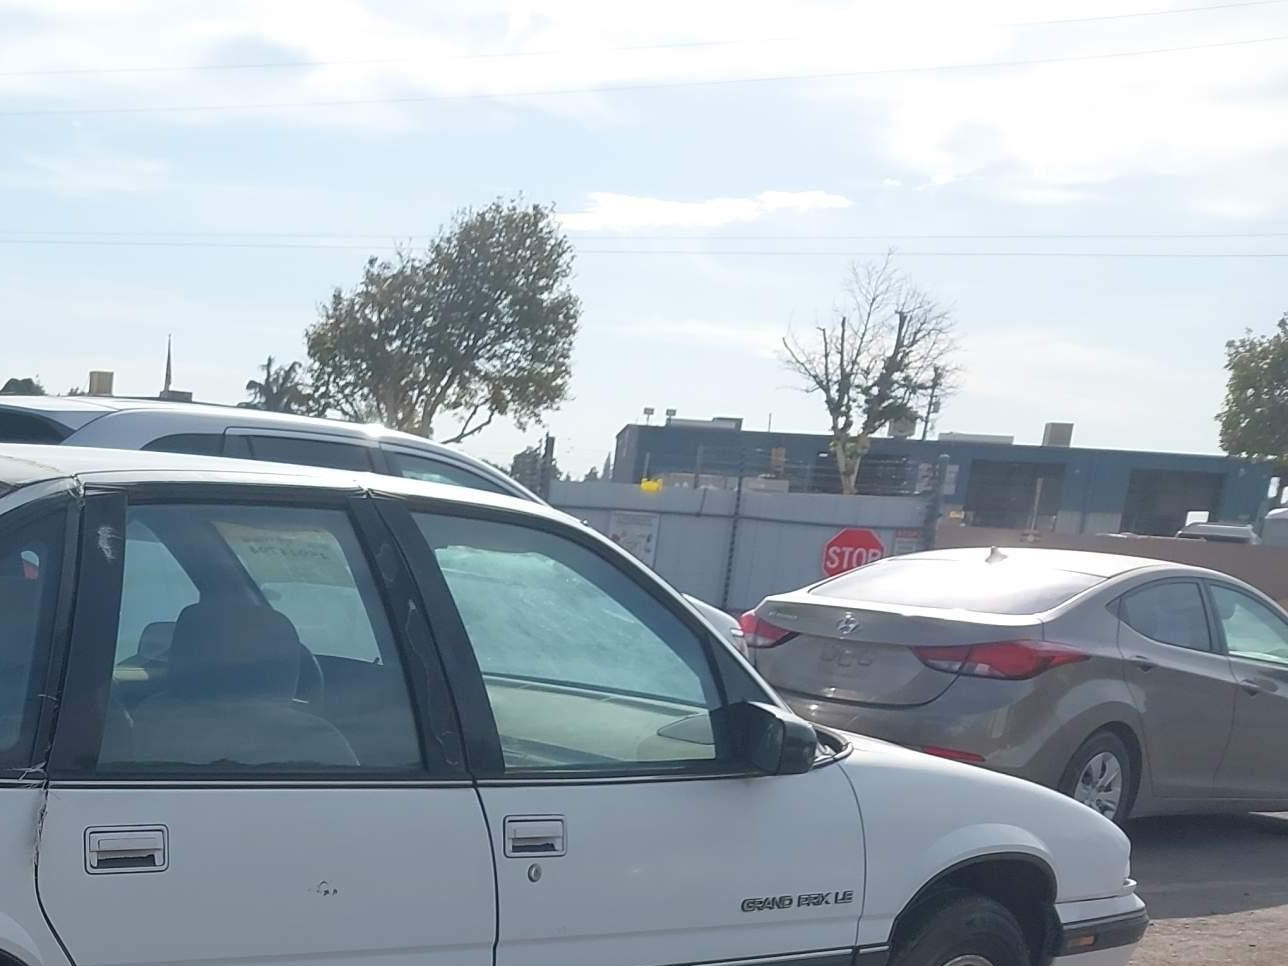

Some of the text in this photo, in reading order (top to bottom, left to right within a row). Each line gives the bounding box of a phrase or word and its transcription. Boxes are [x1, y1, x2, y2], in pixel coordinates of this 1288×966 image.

[826, 545, 881, 569] STOP
[741, 895, 793, 912] GRAND
[834, 890, 854, 904] LE
